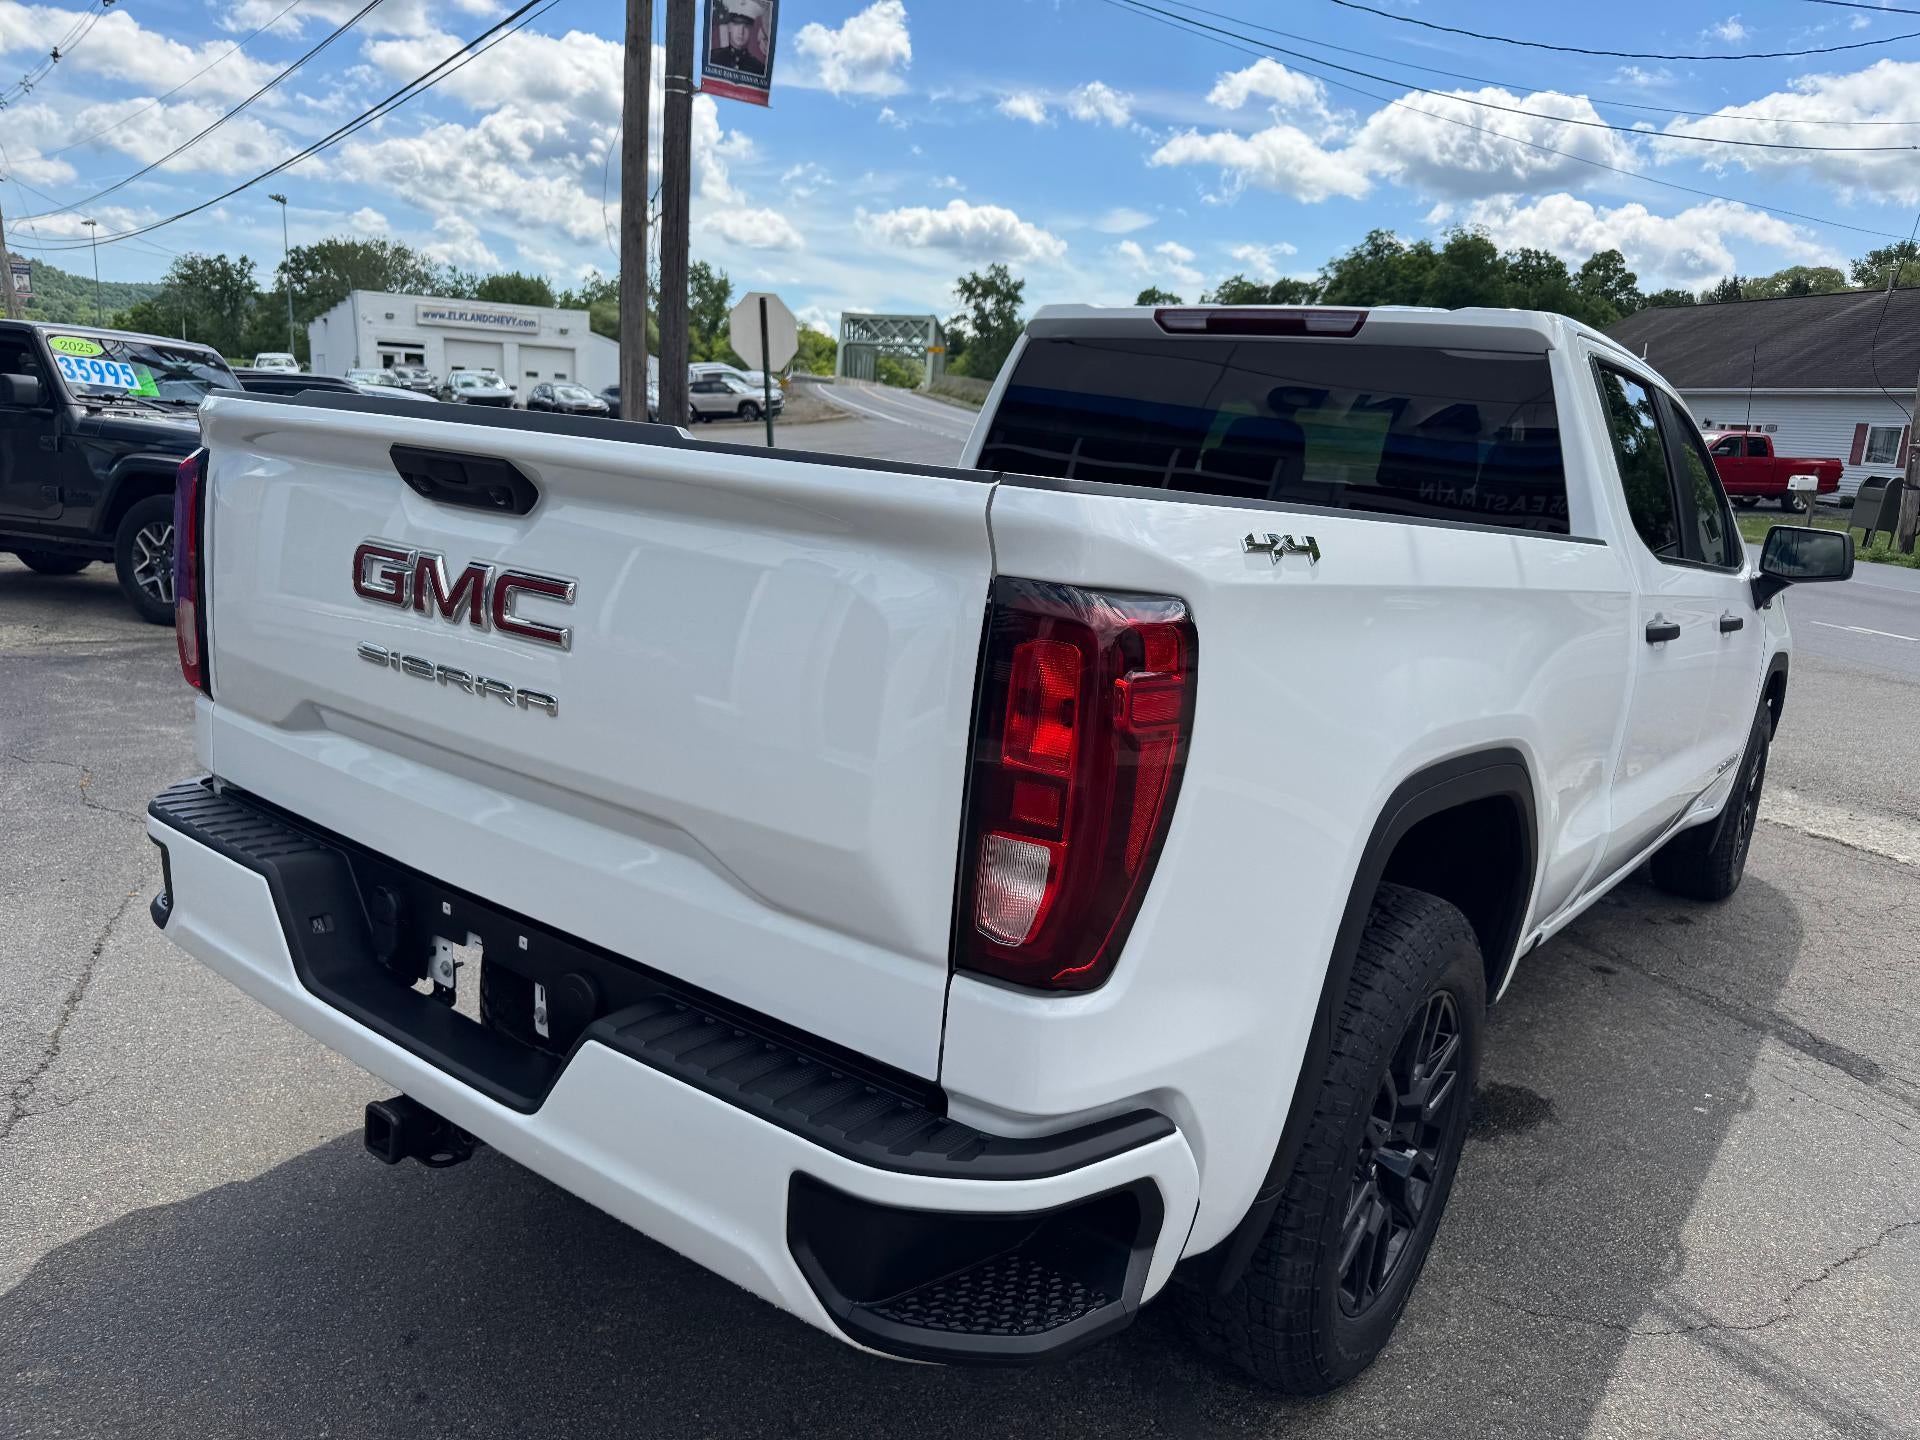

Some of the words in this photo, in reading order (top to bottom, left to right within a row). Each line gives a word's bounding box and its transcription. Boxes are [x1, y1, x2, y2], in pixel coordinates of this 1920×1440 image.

[422, 310, 537, 328] www.ELKLANDCHEVY.com
[60, 340, 94, 354] 2025
[58, 356, 136, 388] 35995
[352, 536, 580, 652] GMC
[356, 640, 559, 718] SIERRA
